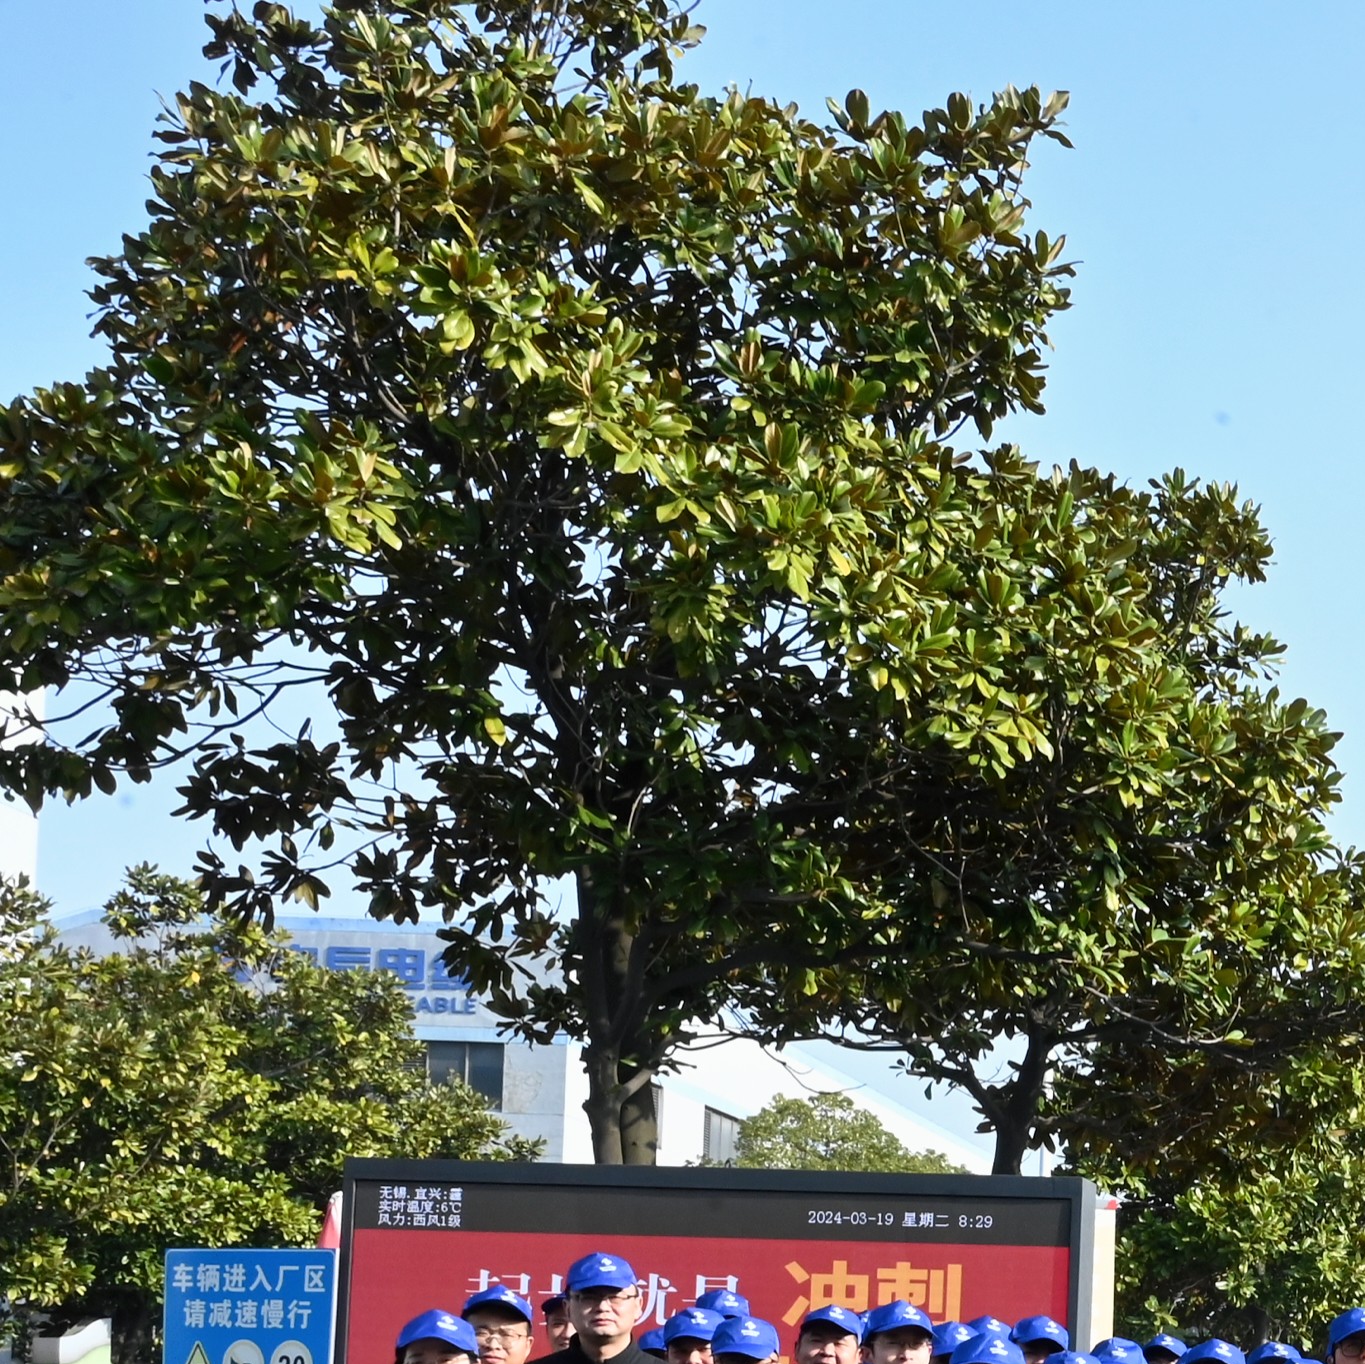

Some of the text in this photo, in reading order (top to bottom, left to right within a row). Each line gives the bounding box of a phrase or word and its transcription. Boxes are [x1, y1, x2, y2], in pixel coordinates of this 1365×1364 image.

[808, 1211, 993, 1229] 2024-03-19 星期二 8:29
[172, 1263, 326, 1293] 车辆进入厂区
[183, 1299, 312, 1329] 请减速慢行
